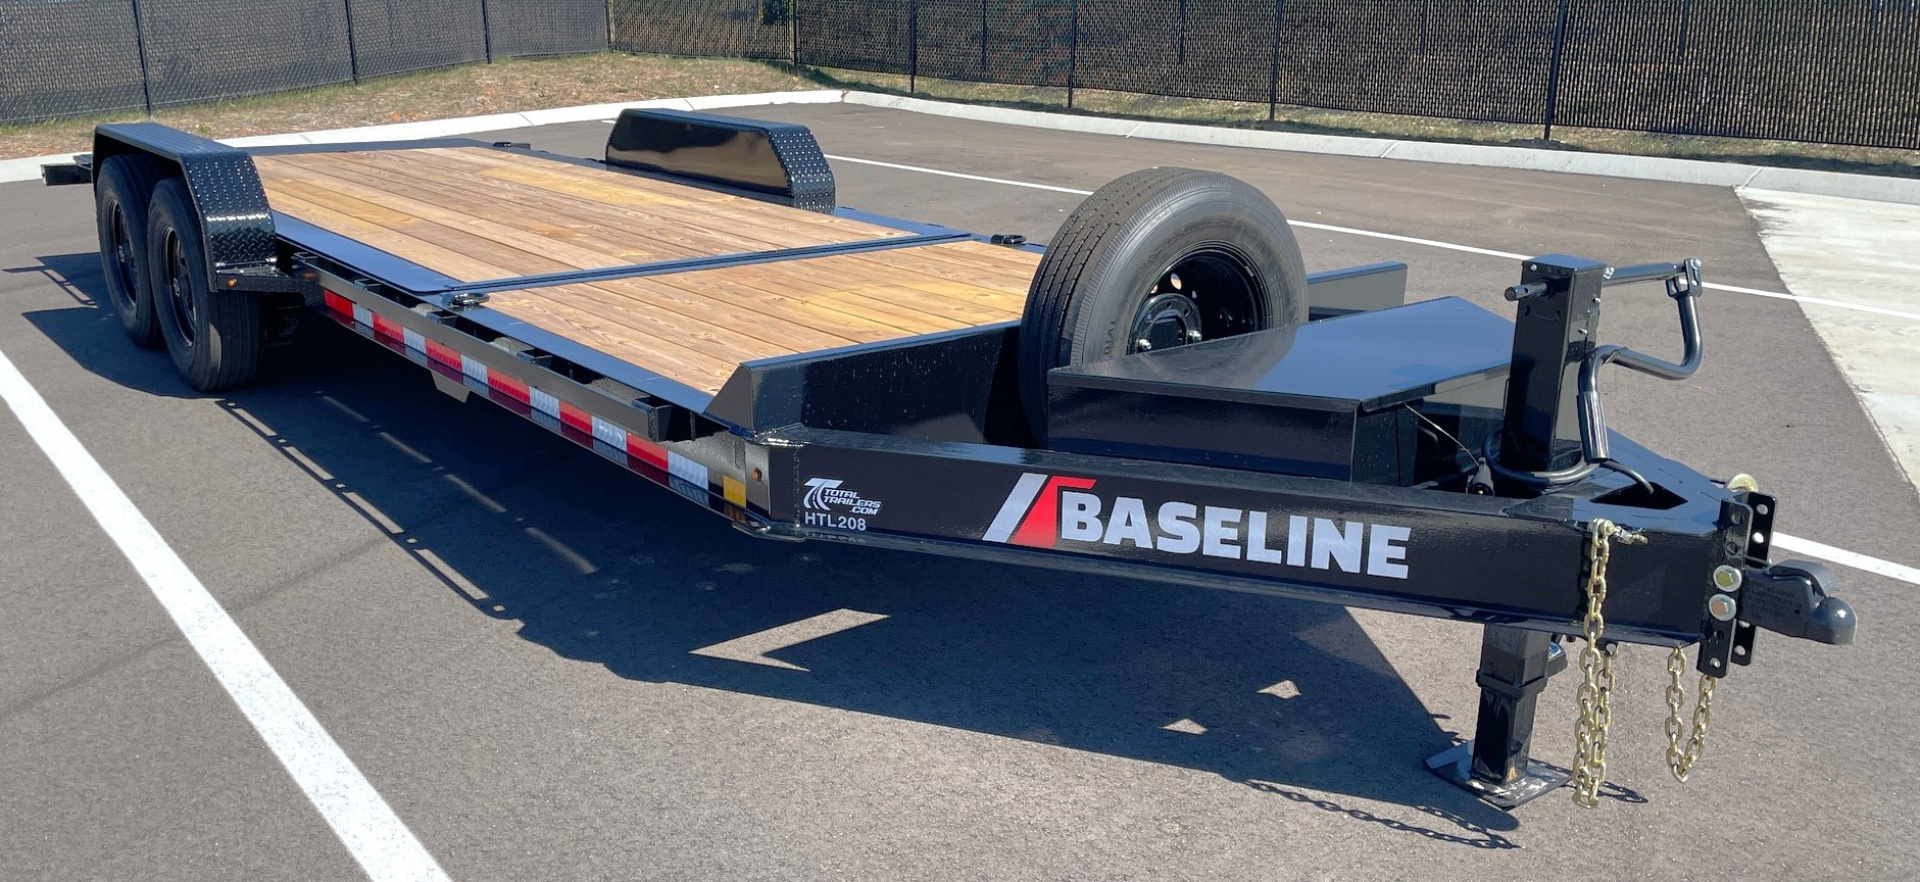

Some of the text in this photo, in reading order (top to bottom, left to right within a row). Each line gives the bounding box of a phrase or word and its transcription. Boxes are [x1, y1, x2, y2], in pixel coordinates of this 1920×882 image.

[824, 488, 860, 499] TOTAL
[823, 495, 882, 508] TRAILERS
[849, 506, 879, 516] .COM
[804, 511, 867, 531] HTL208
[1061, 490, 1412, 580] BASELINE
